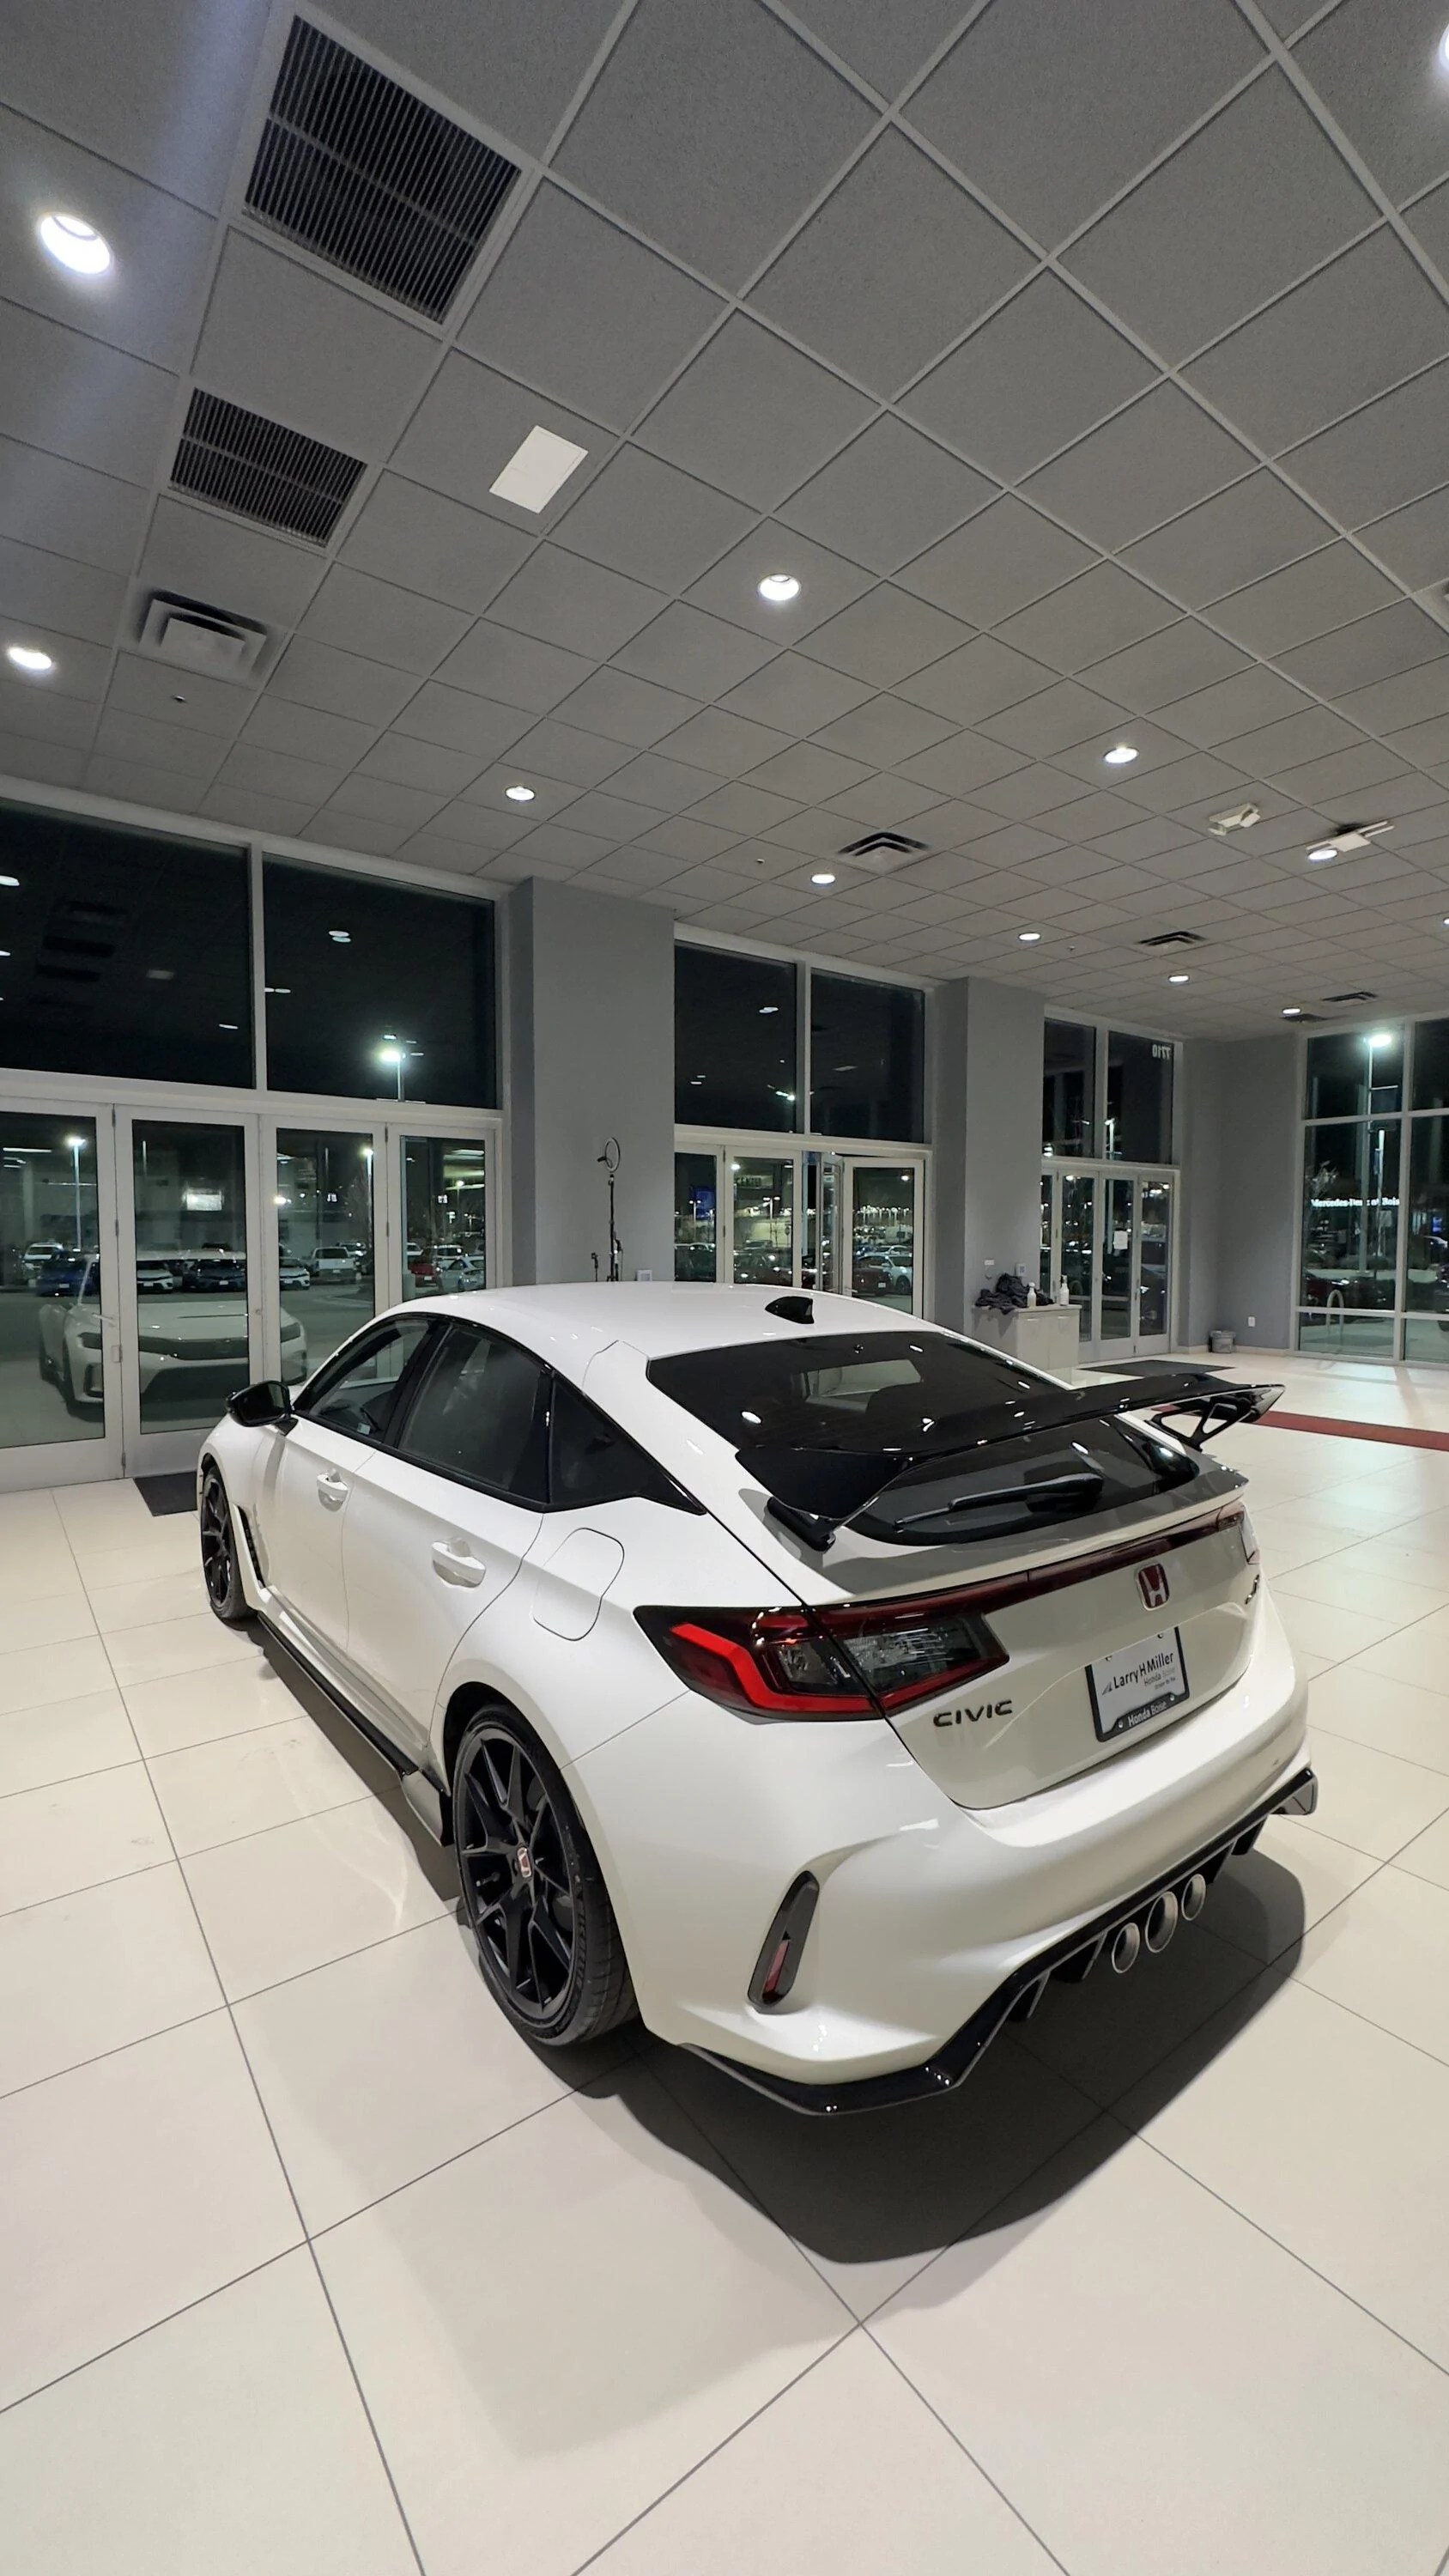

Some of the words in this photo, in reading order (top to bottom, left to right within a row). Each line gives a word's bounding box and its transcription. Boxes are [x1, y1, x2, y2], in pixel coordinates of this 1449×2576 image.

[1382, 1196, 1400, 1206] Bois
[1113, 1669, 1138, 1689] Larry
[1138, 1663, 1147, 1677] H
[1147, 1652, 1174, 1673] Miller
[933, 1699, 1013, 1727] CIVIC
[1127, 1707, 1150, 1727] Honda
